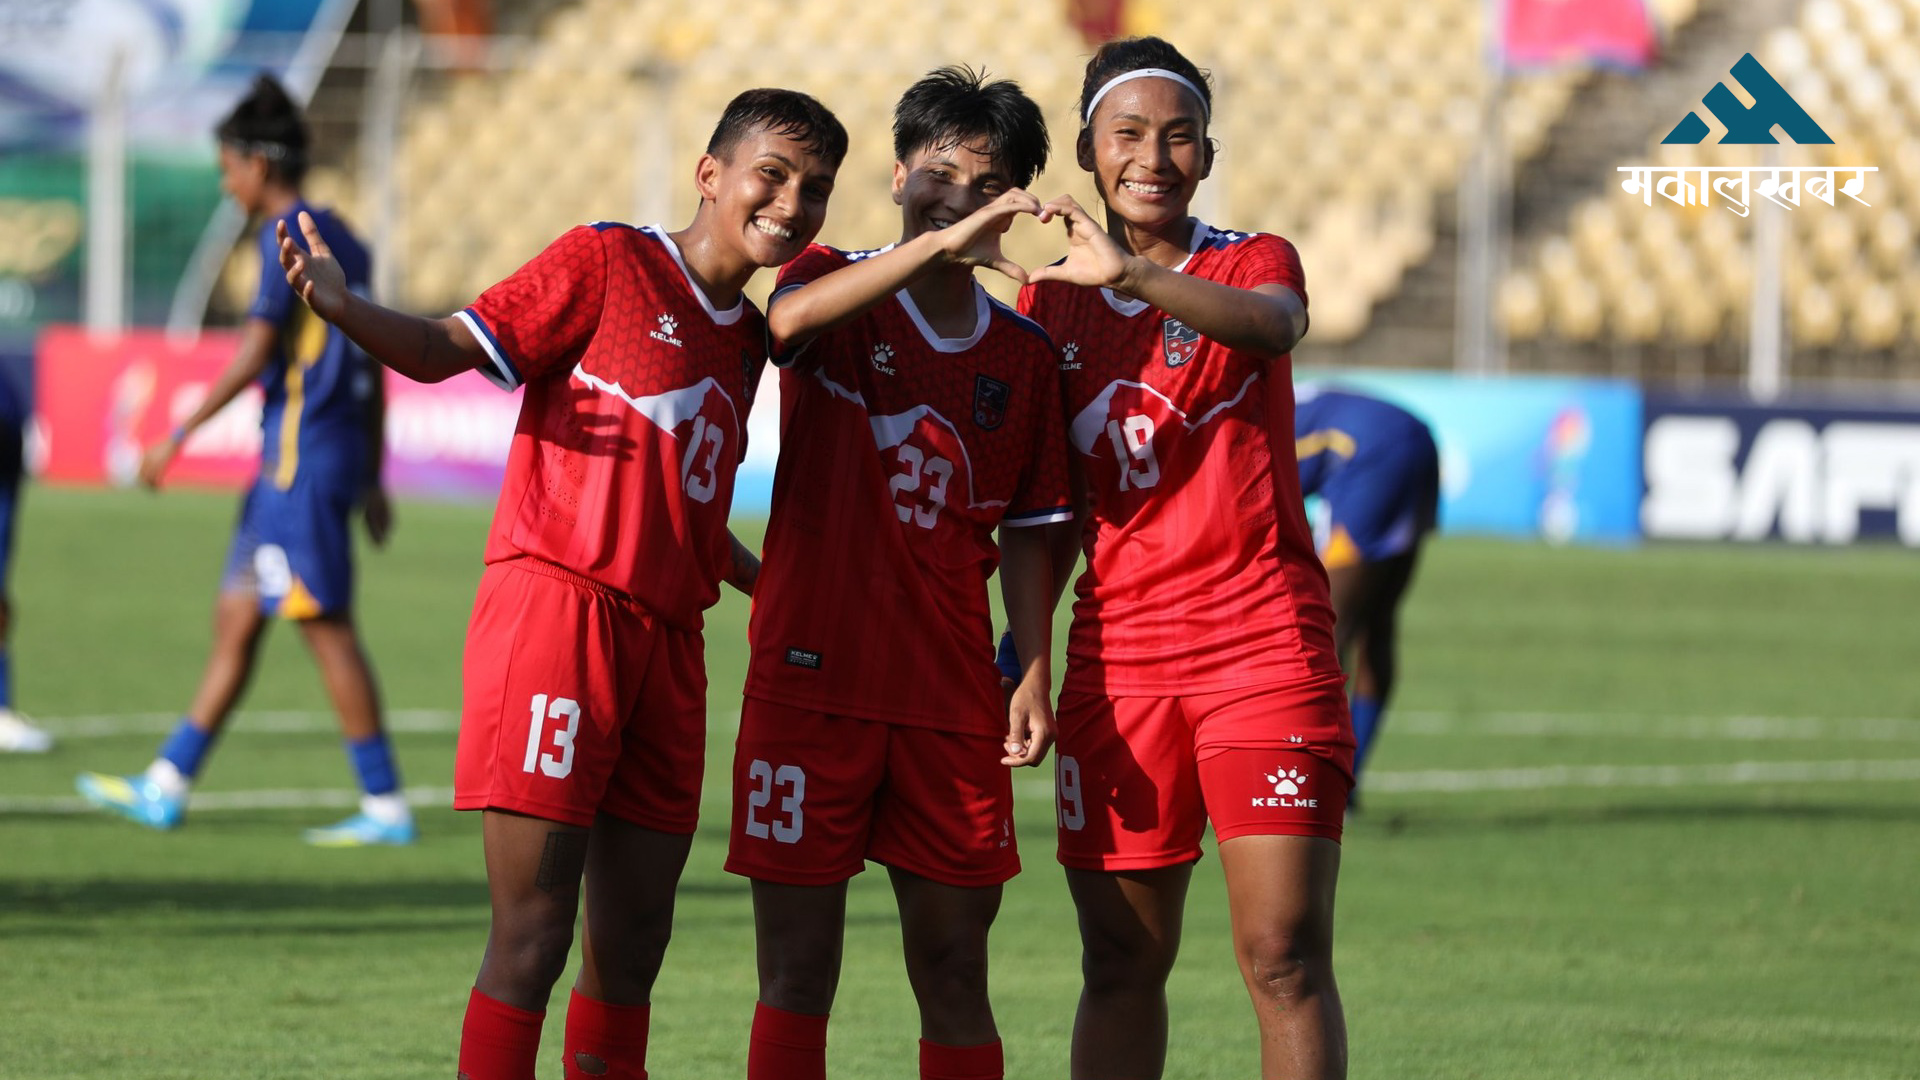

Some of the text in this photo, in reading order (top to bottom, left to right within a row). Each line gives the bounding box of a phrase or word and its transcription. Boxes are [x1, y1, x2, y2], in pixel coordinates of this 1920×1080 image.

[650, 330, 682, 347] KELME
[871, 354, 896, 376] LME
[682, 415, 724, 503] 13
[889, 443, 953, 529] 23
[1107, 414, 1160, 491] 19
[1639, 415, 1920, 547] SAF
[523, 693, 581, 779] 13
[745, 758, 805, 844] 23
[1252, 797, 1318, 808] KELME
